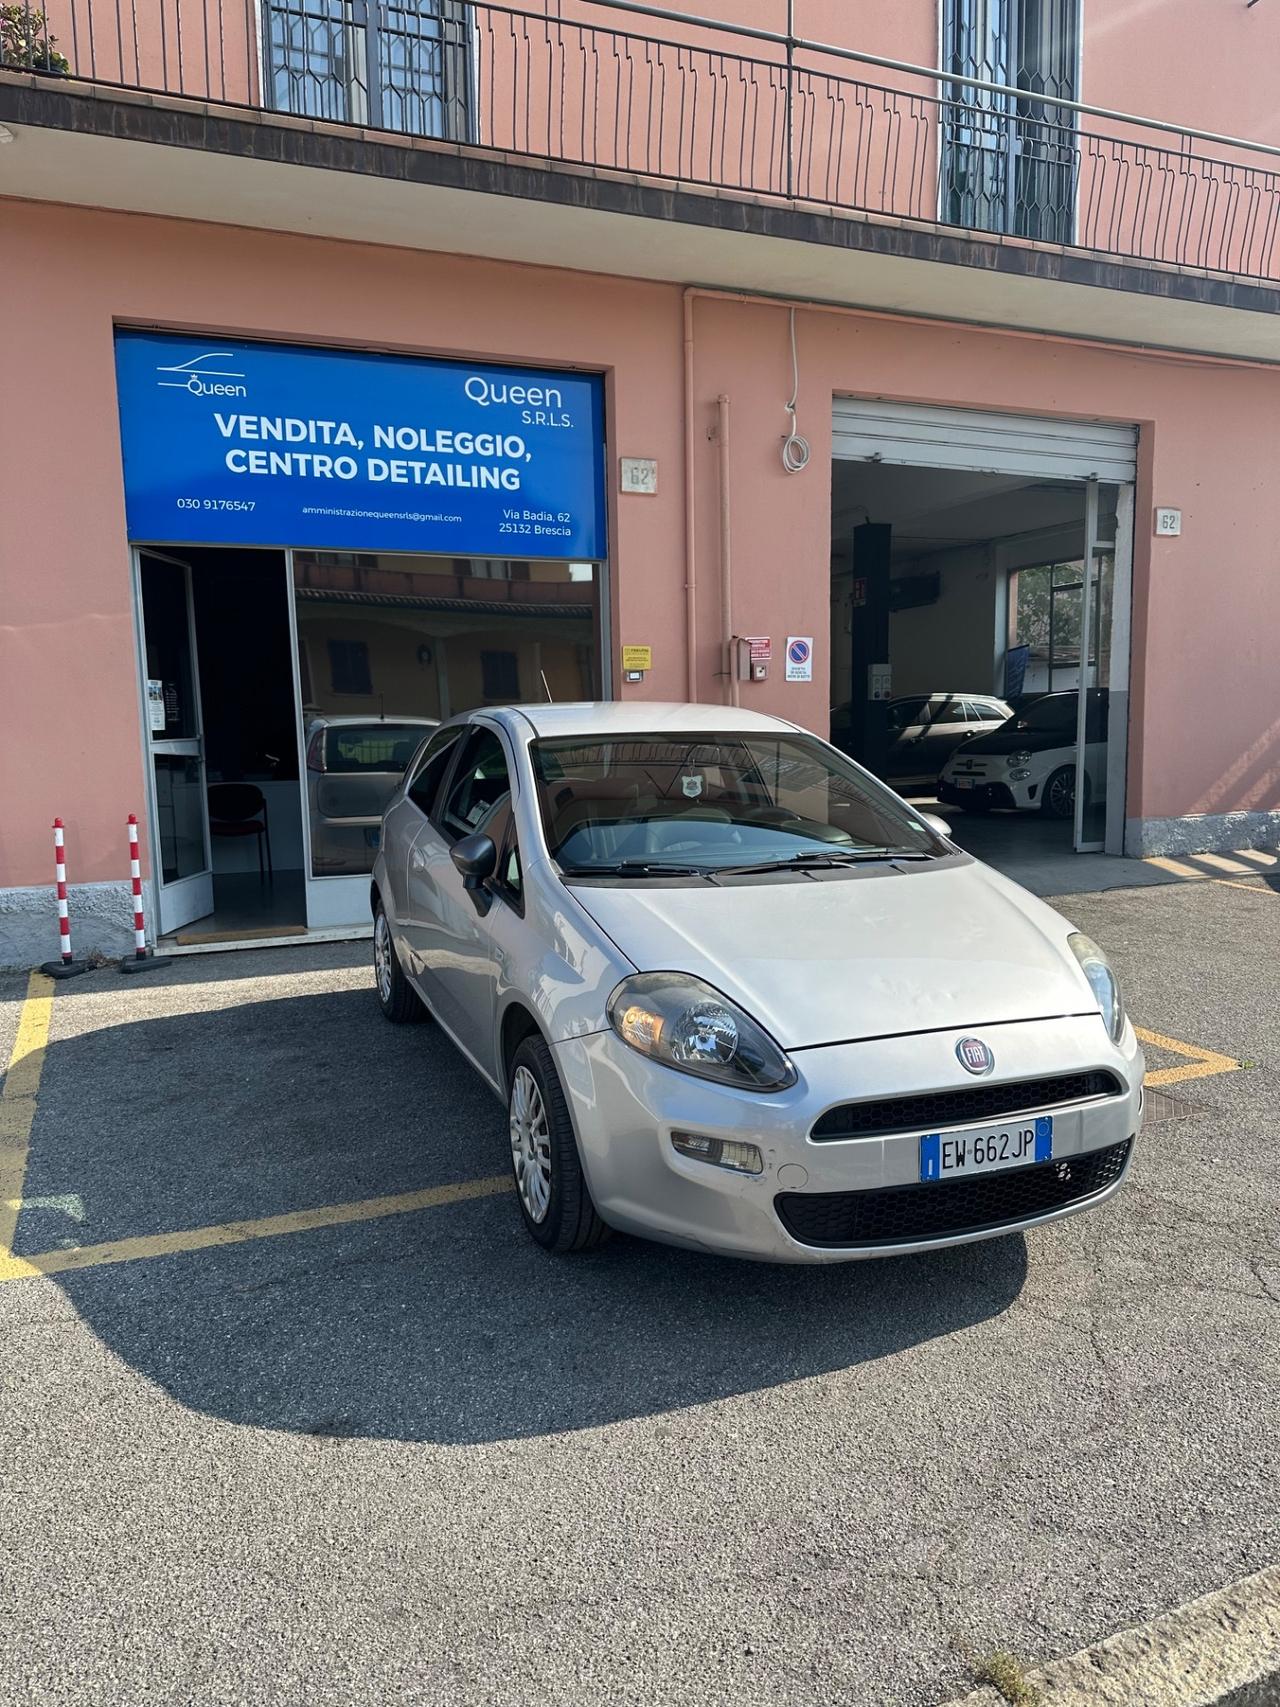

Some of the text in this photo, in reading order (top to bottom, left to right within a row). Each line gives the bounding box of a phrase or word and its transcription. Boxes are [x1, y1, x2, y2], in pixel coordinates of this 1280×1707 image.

[187, 379, 247, 398] Queen
[464, 376, 562, 408] Queen
[521, 410, 574, 428] S.R.L.S.
[213, 412, 532, 463] VENDITA, NOLEGGIO,
[225, 449, 521, 491] CENTRO DETAILING
[630, 466, 649, 486] 62
[176, 498, 256, 511] 030 9176547
[302, 506, 463, 523] amministrazionequeensrls@gmail.com
[503, 509, 571, 523] Via Badia, 62
[1163, 515, 1175, 528] 62
[499, 522, 572, 536] 25132 Brescia
[965, 1045, 985, 1063] FIAT
[942, 1140, 966, 1169] EW
